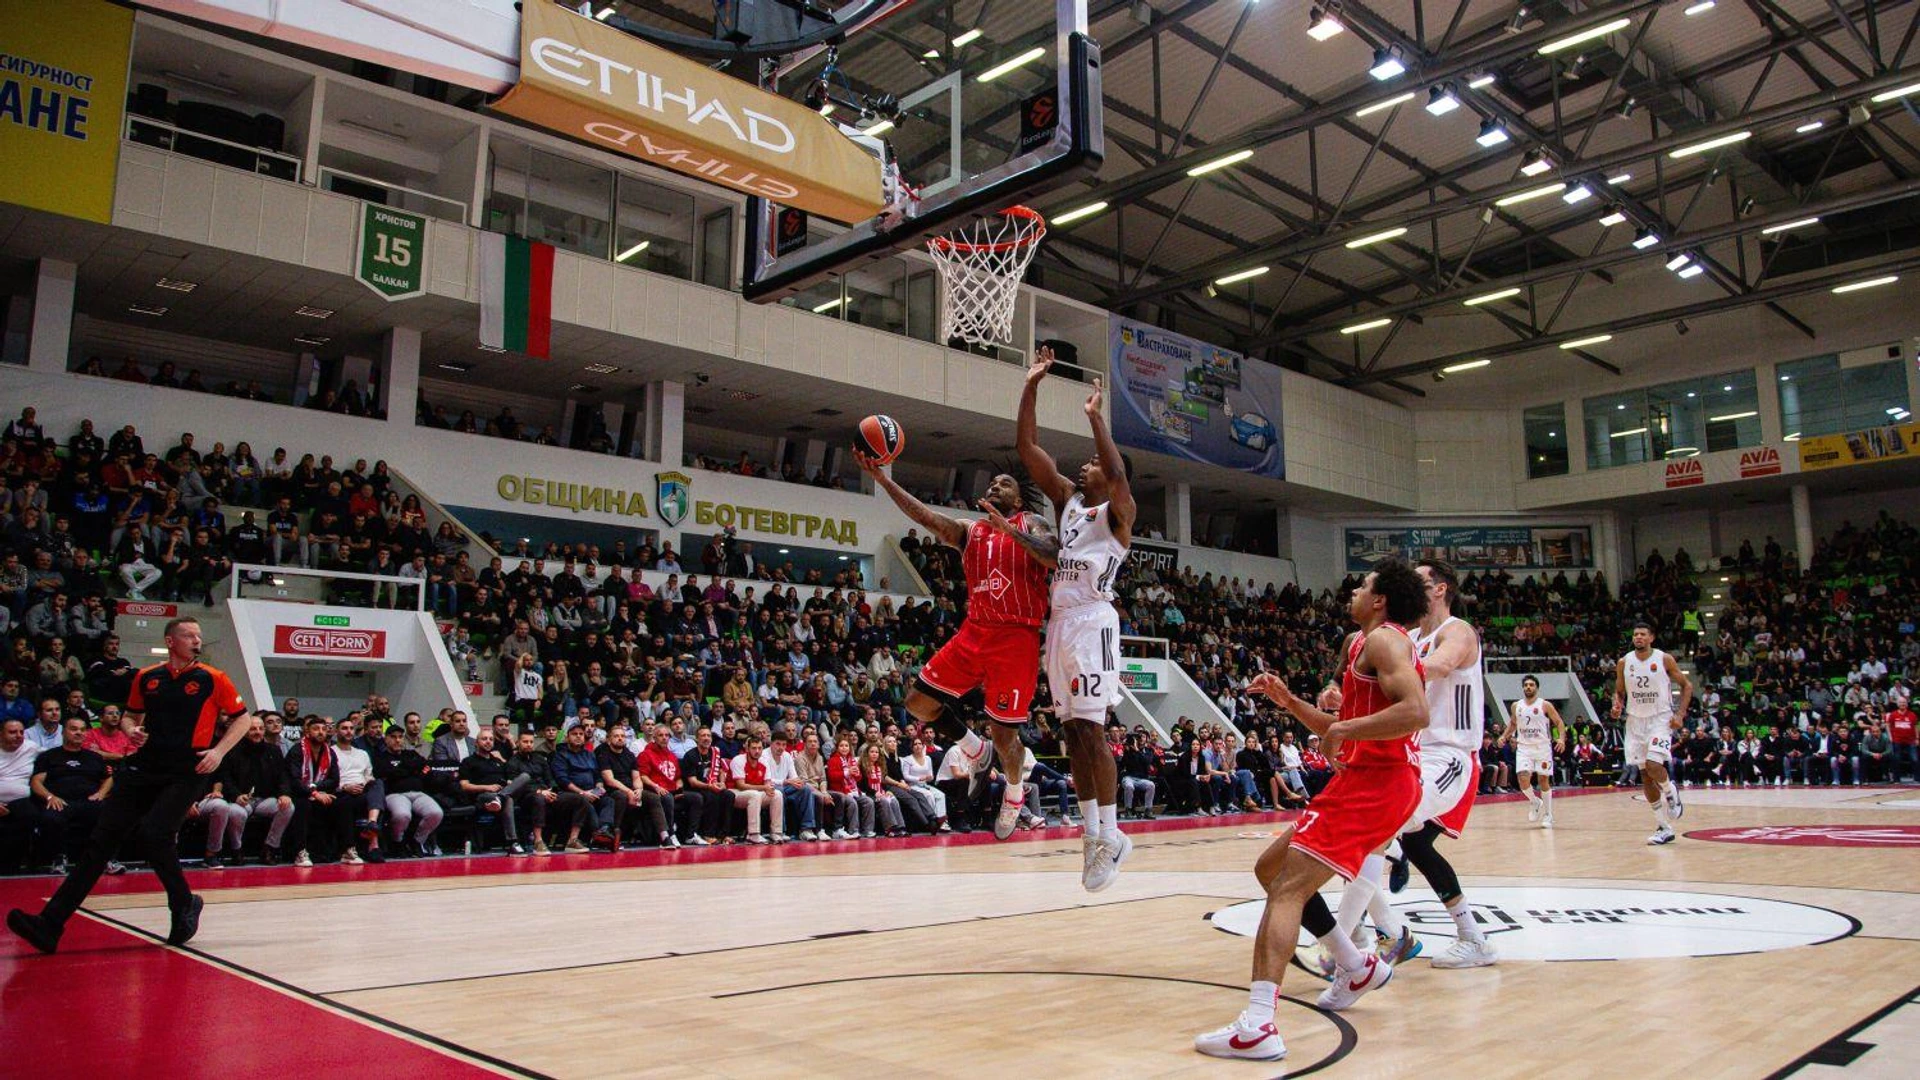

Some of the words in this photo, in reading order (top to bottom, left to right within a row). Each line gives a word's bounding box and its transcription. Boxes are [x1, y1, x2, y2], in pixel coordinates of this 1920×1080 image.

[529, 36, 796, 154] ETIHAD
[583, 122, 799, 199] ETIHAD
[374, 212, 417, 230] ХРИСТОВ
[373, 232, 411, 267] 15
[372, 273, 409, 289] БАЛКАН
[497, 474, 648, 517] ОБЩИНА
[695, 500, 858, 545] БОТЕВГРАД
[986, 540, 994, 560] 1
[1131, 550, 1174, 571] SPORT
[294, 634, 325, 647] CETA
[331, 637, 368, 650] FORM
[1080, 674, 1101, 697] 12
[1636, 676, 1650, 688] 22
[1012, 689, 1020, 711] 1
